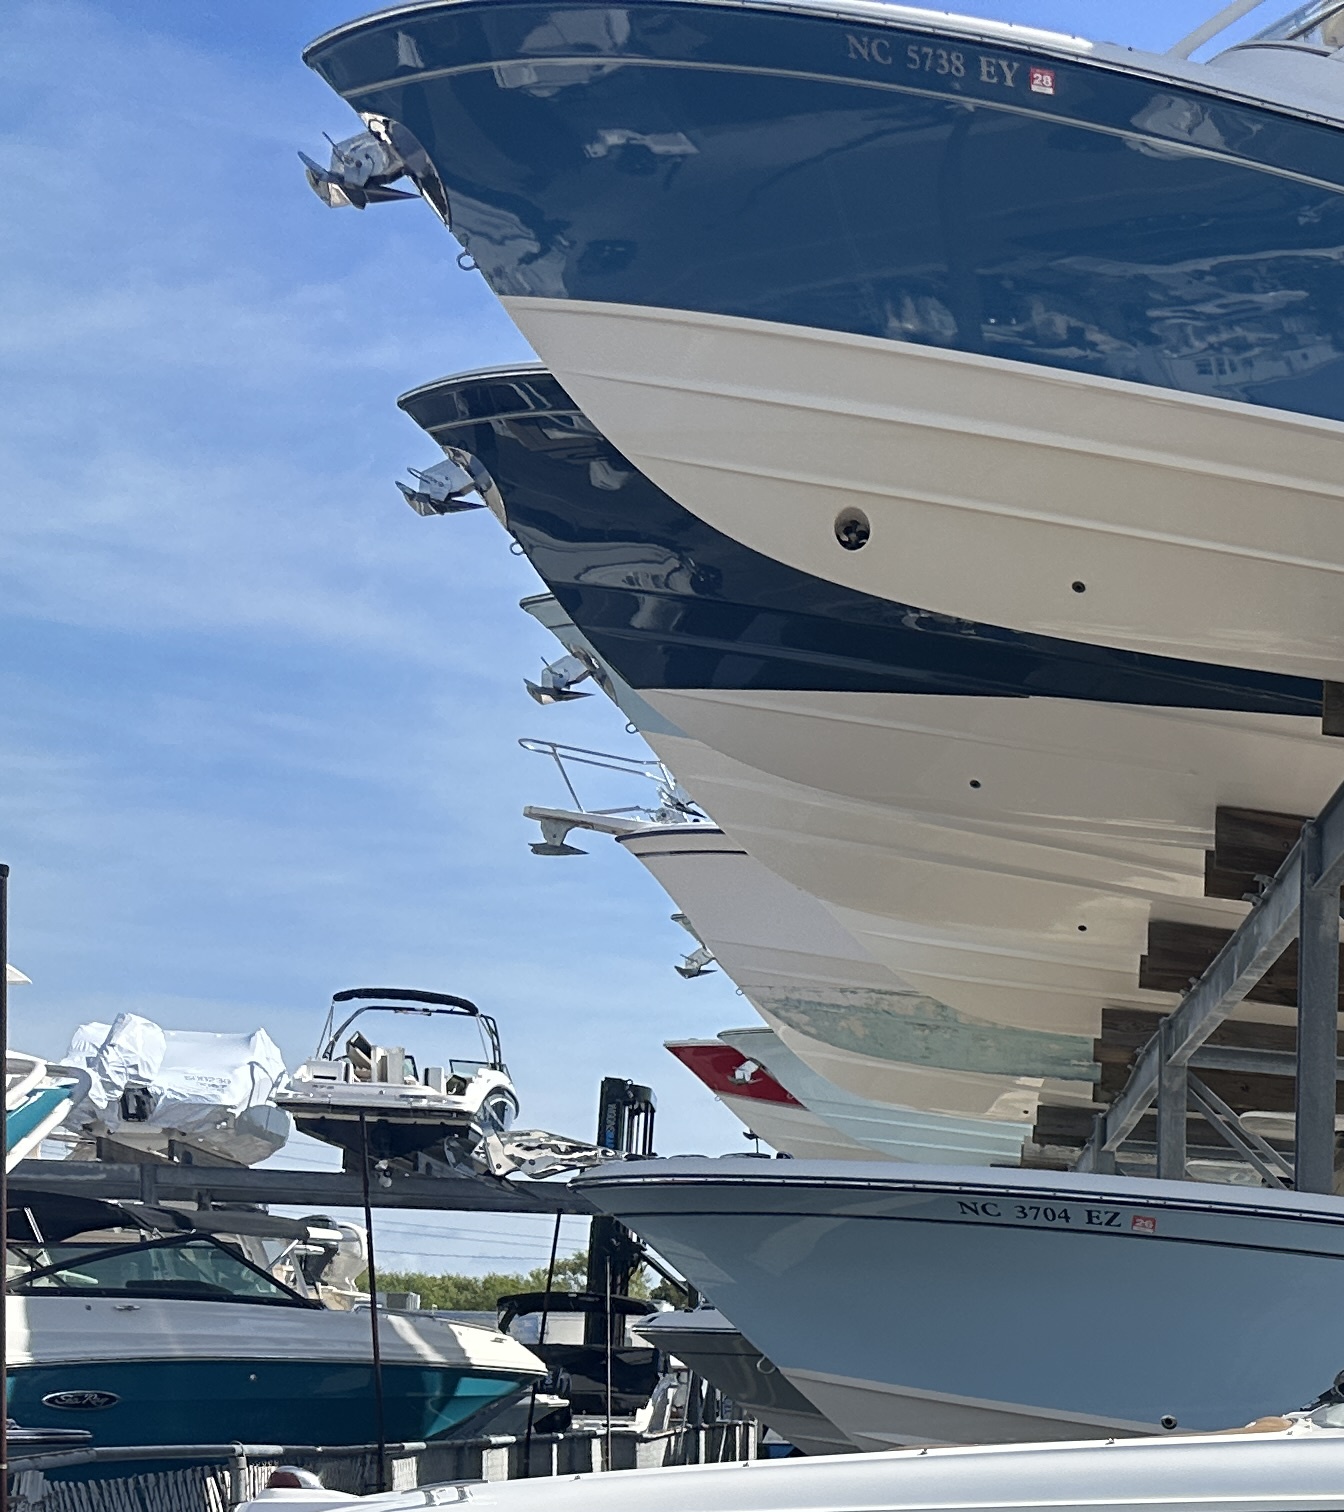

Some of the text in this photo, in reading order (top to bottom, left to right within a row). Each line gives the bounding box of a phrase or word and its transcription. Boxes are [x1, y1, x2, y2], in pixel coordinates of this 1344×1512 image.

[845, 34, 1020, 87] NC 5738 EY
[1032, 73, 1053, 87] 28
[957, 1201, 1121, 1228] NC 3704 EZ
